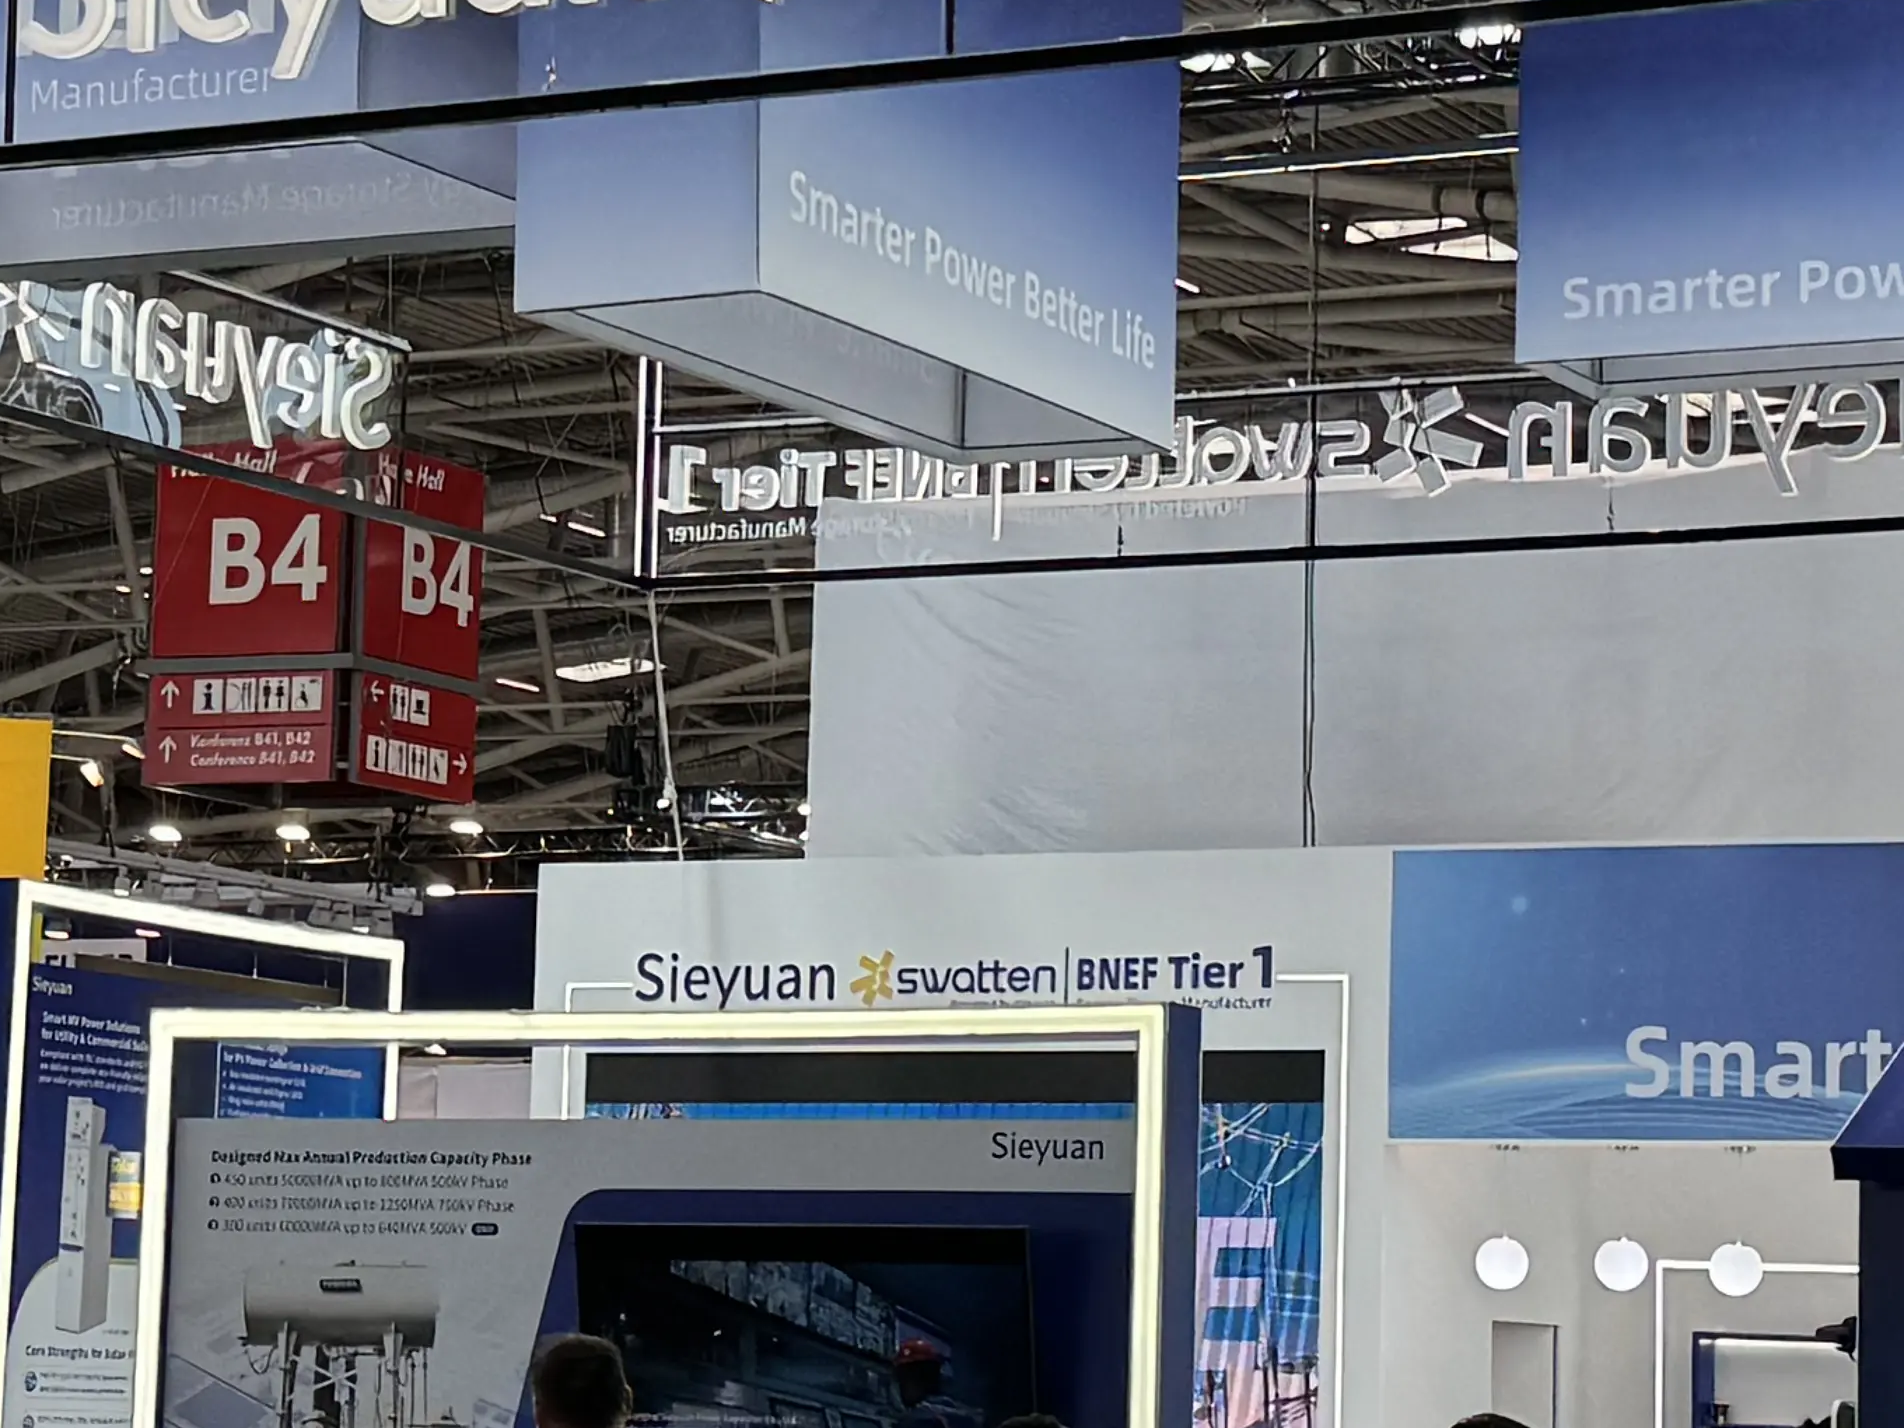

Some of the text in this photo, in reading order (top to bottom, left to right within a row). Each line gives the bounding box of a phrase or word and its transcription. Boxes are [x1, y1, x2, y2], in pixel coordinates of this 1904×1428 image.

[31, 66, 272, 114] Manufacturer
[790, 172, 1156, 369] Smarter Power Better Life
[1562, 263, 1779, 322] Smarter
[208, 513, 327, 605] B4
[402, 525, 474, 628] B4
[634, 945, 1273, 1010] Sieyuan swatten BNEF Tier 1
[1625, 1026, 1892, 1100] Smart
[991, 1131, 1105, 1165] Sieyuan
